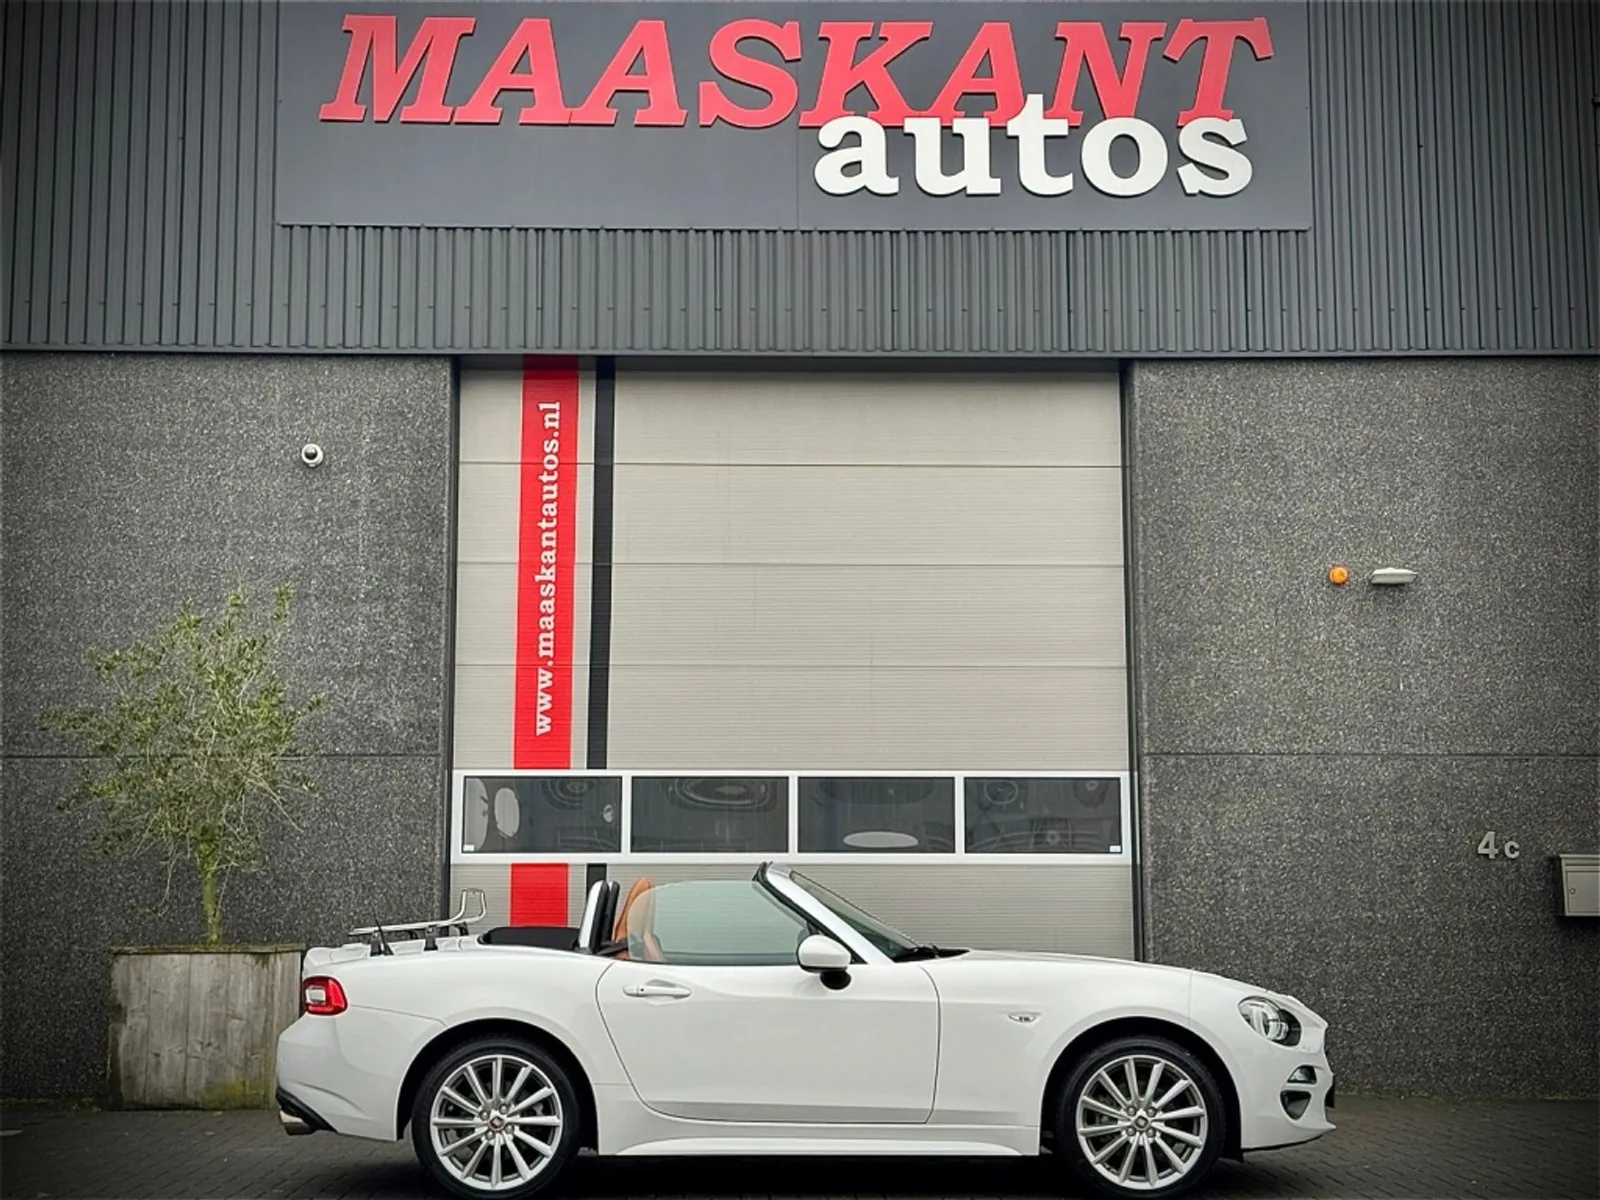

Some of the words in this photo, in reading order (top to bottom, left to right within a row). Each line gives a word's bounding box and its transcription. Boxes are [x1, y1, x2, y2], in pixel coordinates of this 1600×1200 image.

[319, 14, 1274, 128] MAASKANT
[813, 93, 1253, 198] autos
[535, 400, 561, 737] www.maaskantautos.nl
